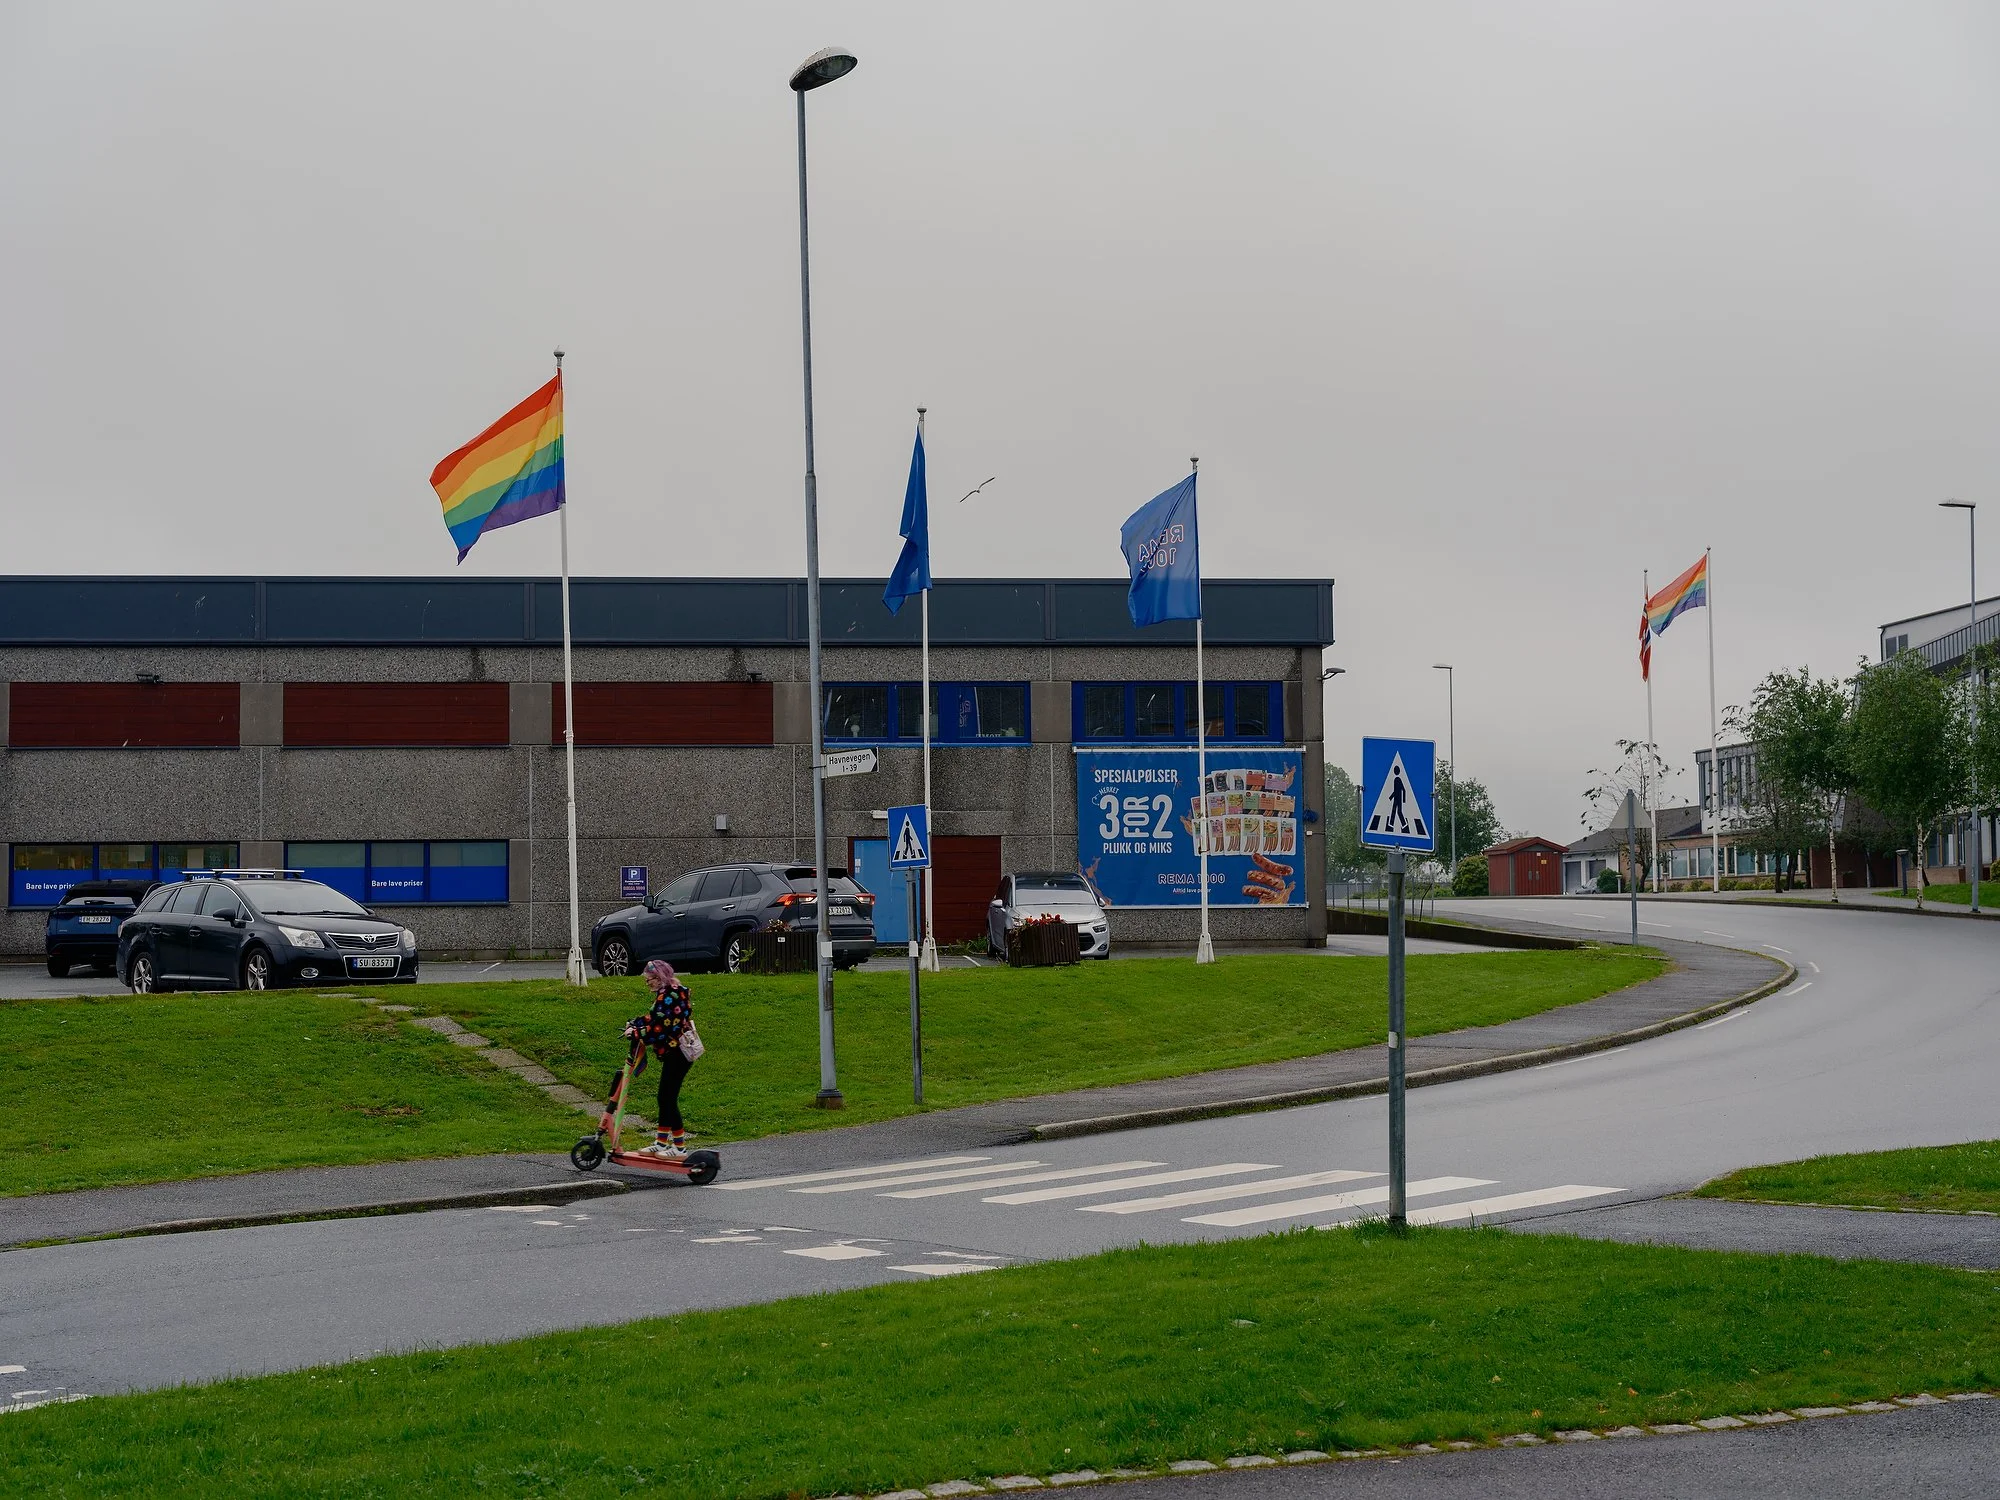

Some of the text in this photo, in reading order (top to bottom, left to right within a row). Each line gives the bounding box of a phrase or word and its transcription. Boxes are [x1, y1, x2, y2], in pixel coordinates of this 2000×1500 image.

[829, 753, 871, 765] Havnevegen
[1094, 769, 1178, 783] SPESIALPØLSER
[1100, 794, 1173, 839] 3 FOR 2
[1103, 842, 1172, 854] PLUKK OG MIKS
[1158, 873, 1226, 885] REMA 100
[25, 882, 42, 890] Bare
[43, 882, 58, 890] lave
[359, 958, 393, 967] SU 83571
